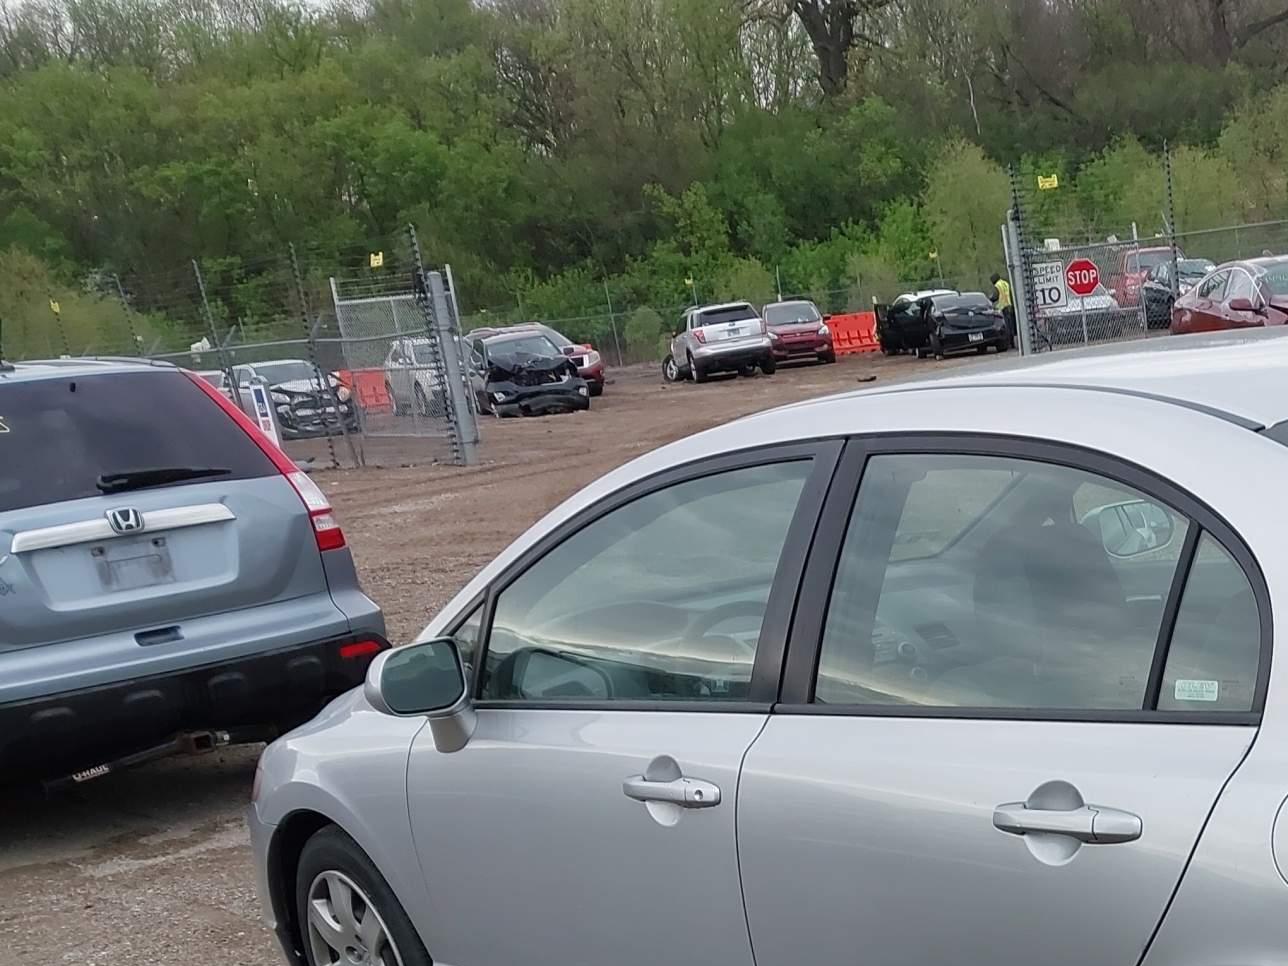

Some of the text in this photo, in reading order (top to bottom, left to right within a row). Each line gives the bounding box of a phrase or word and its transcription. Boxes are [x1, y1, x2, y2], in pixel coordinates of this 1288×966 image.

[1034, 264, 1061, 275] SPEED
[1037, 275, 1060, 285] LIMIT
[1067, 269, 1097, 286] STOP
[1037, 286, 1061, 305] 10
